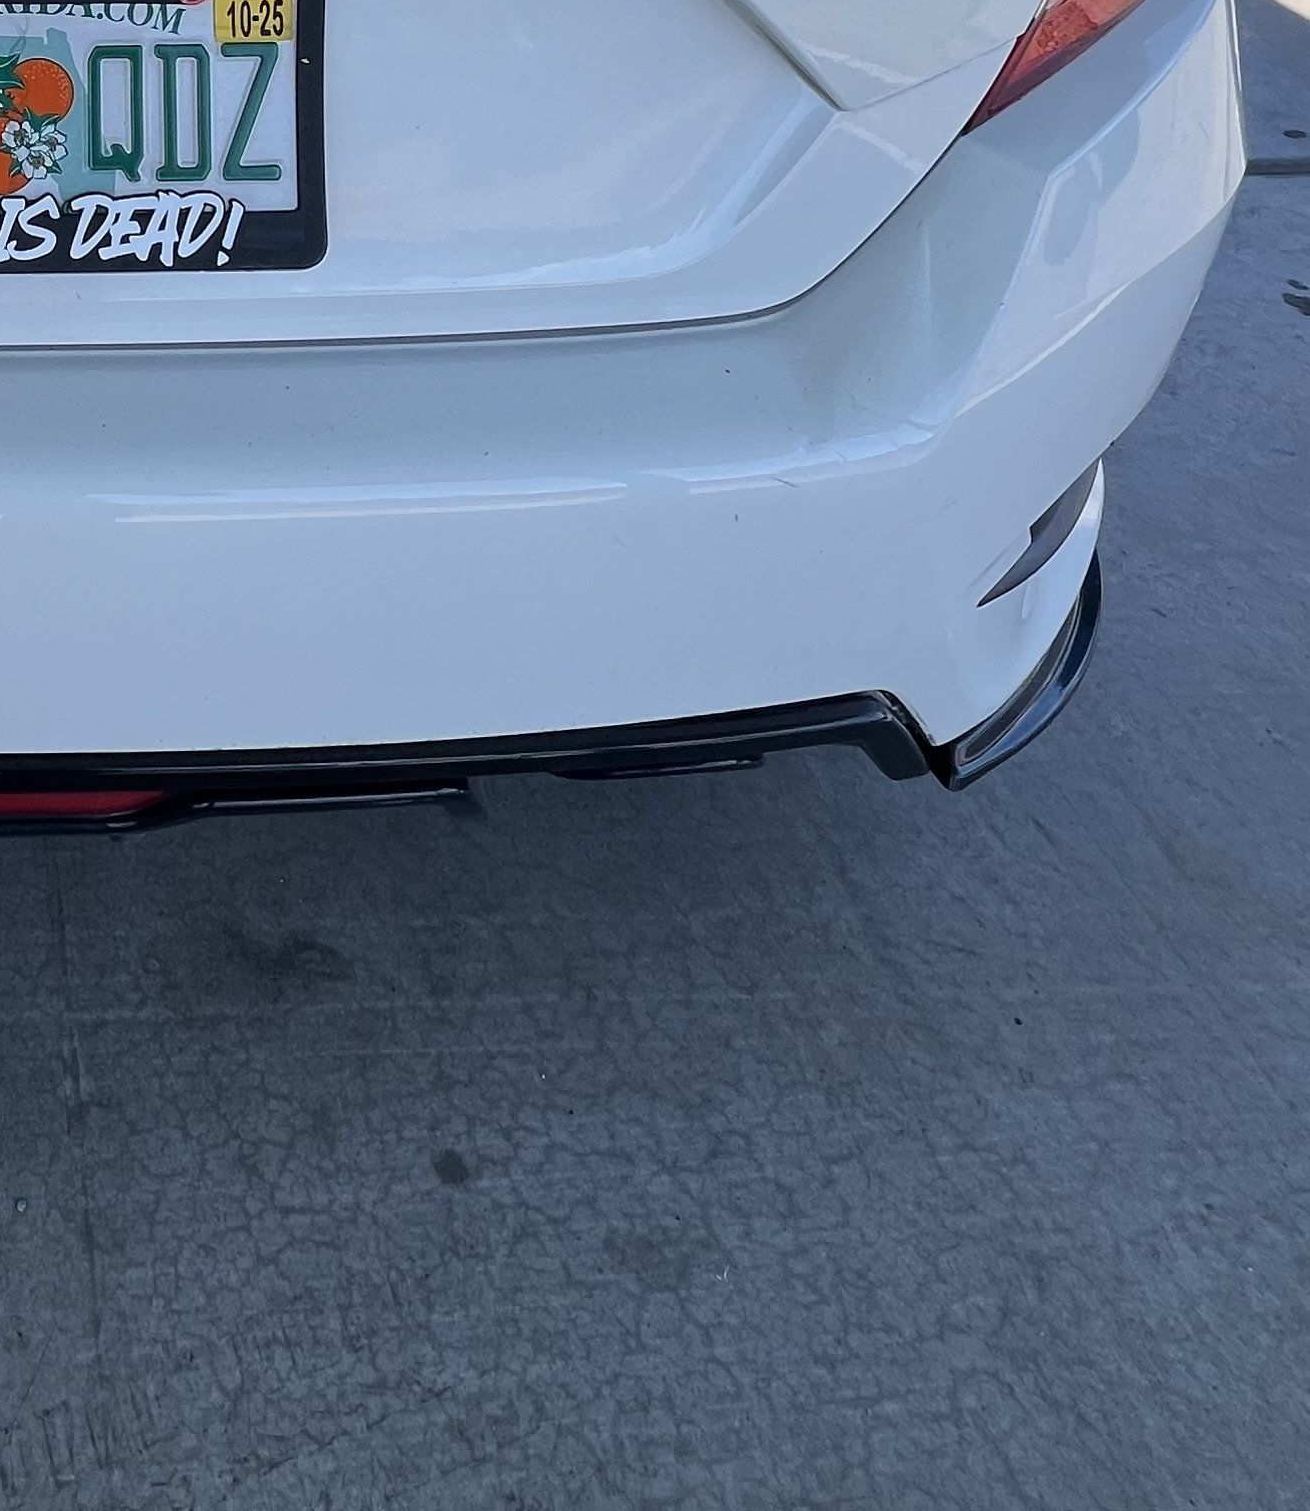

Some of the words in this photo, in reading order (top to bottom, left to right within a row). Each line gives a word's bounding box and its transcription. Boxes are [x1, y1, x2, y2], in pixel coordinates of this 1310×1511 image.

[226, 0, 284, 38] 10-25
[89, 43, 283, 183] QDZ
[69, 191, 246, 267] DEAD!
